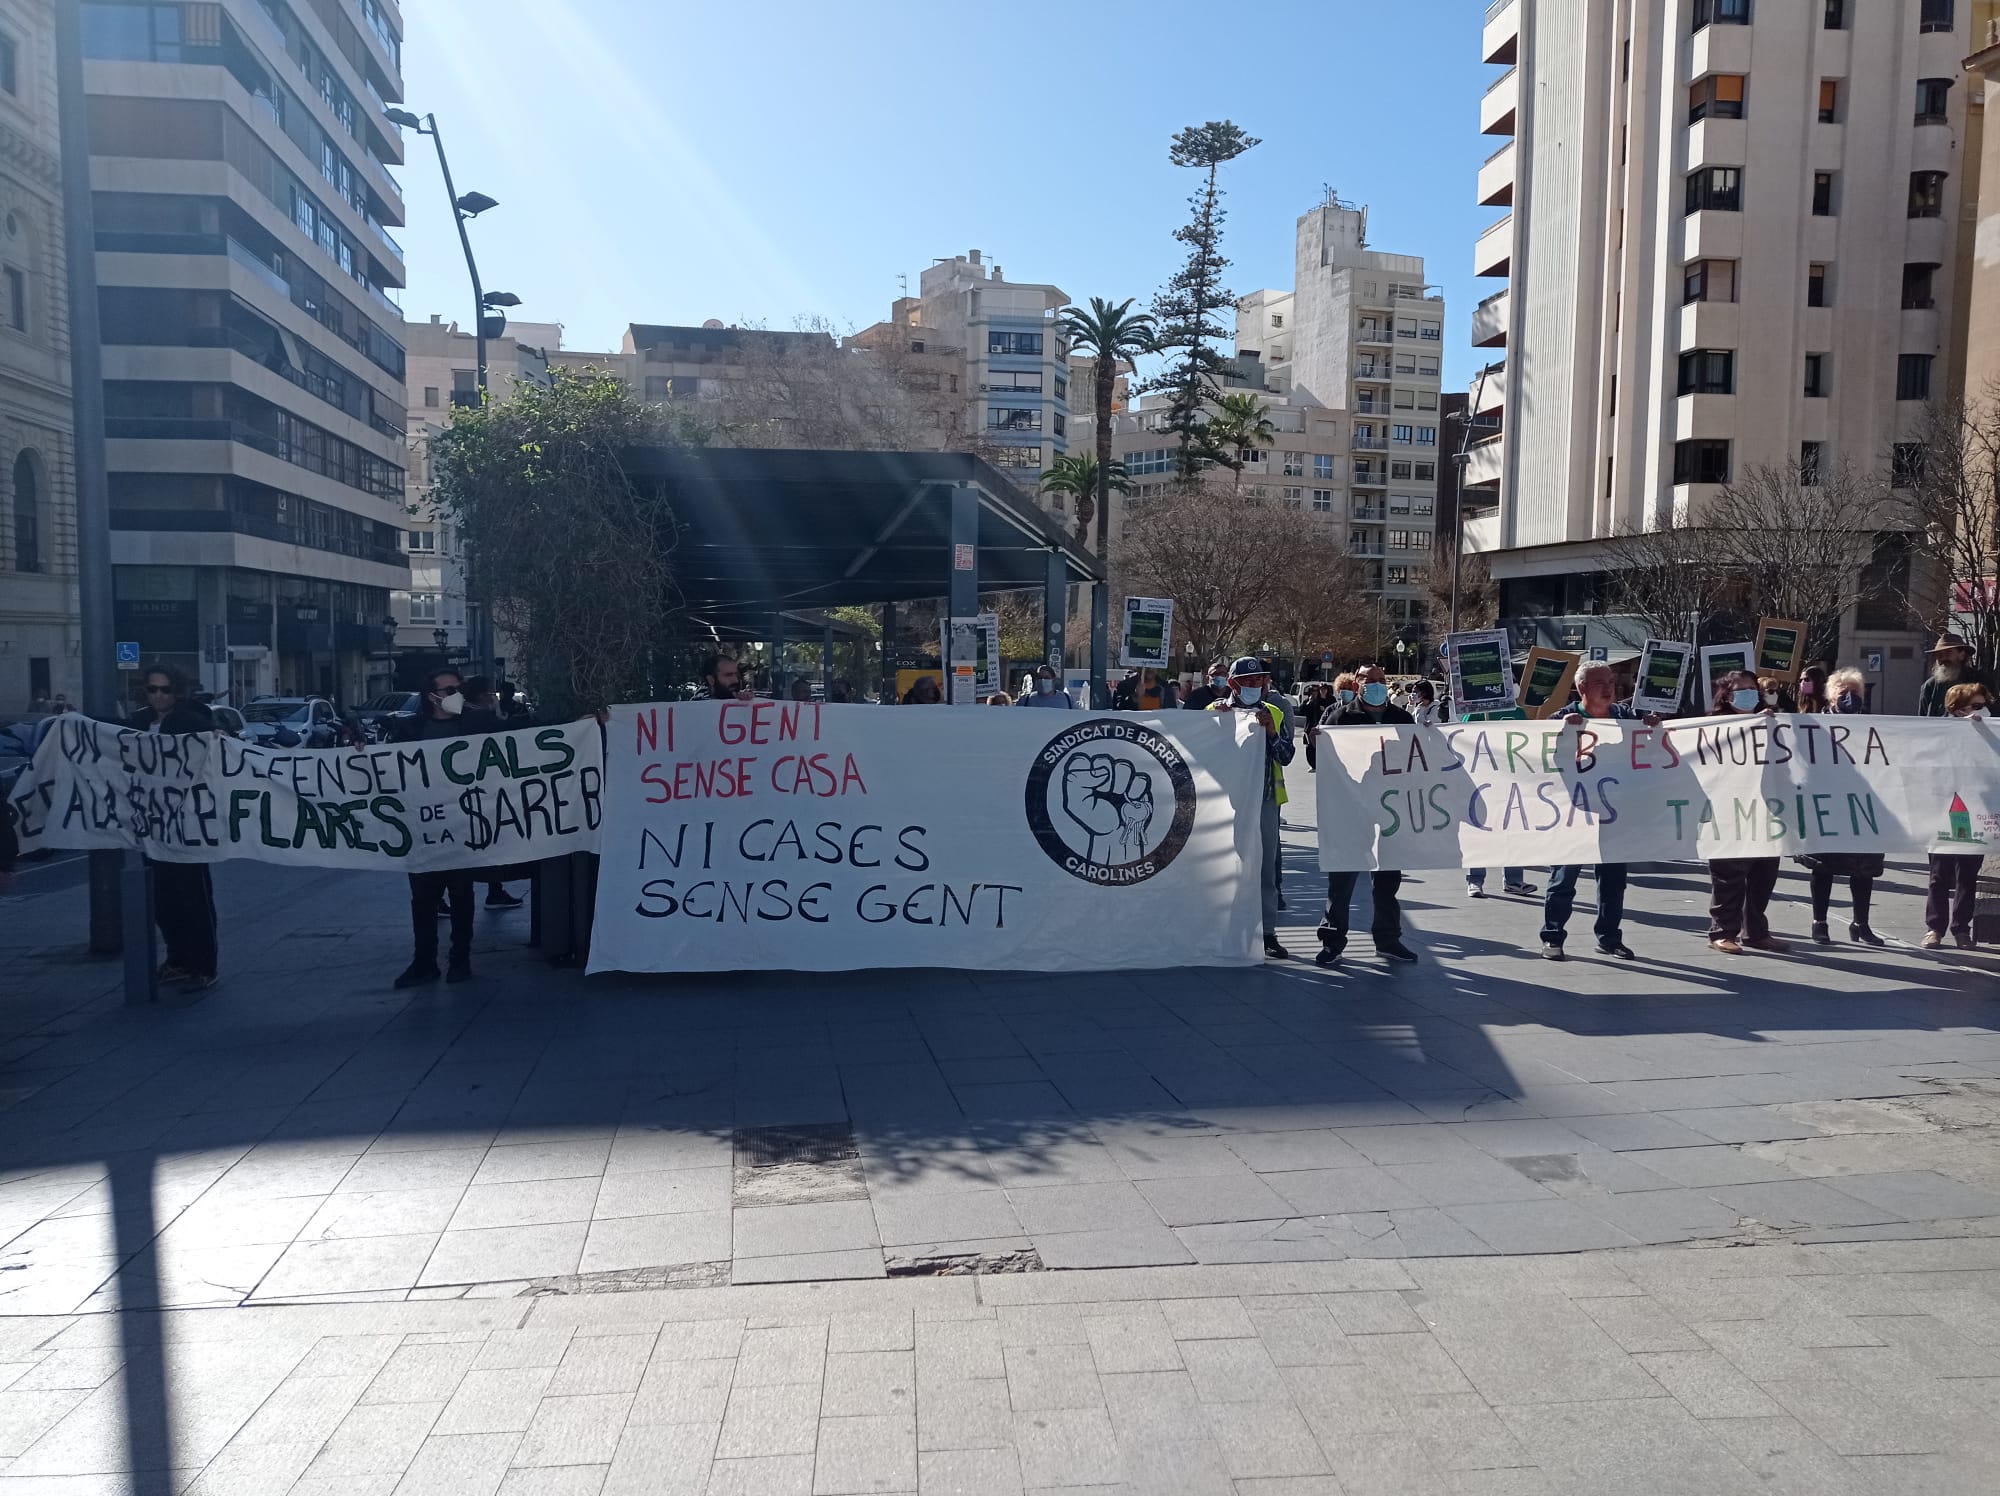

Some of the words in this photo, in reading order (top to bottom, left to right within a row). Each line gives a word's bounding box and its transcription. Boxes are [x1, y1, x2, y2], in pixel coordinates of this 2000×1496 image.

[1594, 649, 1605, 660] P
[60, 719, 101, 764] UN
[636, 706, 674, 756] NI
[718, 701, 826, 745] GENT
[1043, 725, 1111, 764] SINDICAT
[1114, 725, 1135, 740] DE
[1136, 732, 1180, 769] BARRI
[1380, 733, 1429, 776] LA
[1441, 729, 1599, 774] SAREB
[1631, 728, 1680, 770] ES
[1697, 723, 1890, 766] NUESTRA
[220, 738, 430, 797] DEFENSEM
[441, 728, 575, 785] CALS
[640, 756, 758, 804] SENSE
[771, 752, 867, 798] CASA
[229, 789, 413, 858] FLARES
[420, 804, 446, 822] DE
[1380, 783, 1451, 838] SUS
[1468, 776, 1620, 831] CASAS
[423, 829, 455, 845] LA
[638, 821, 715, 869] NI
[738, 818, 930, 872] CASES
[1065, 856, 1155, 881] CAROLINES
[635, 878, 833, 925] SENSE
[856, 882, 1023, 929] GENT
